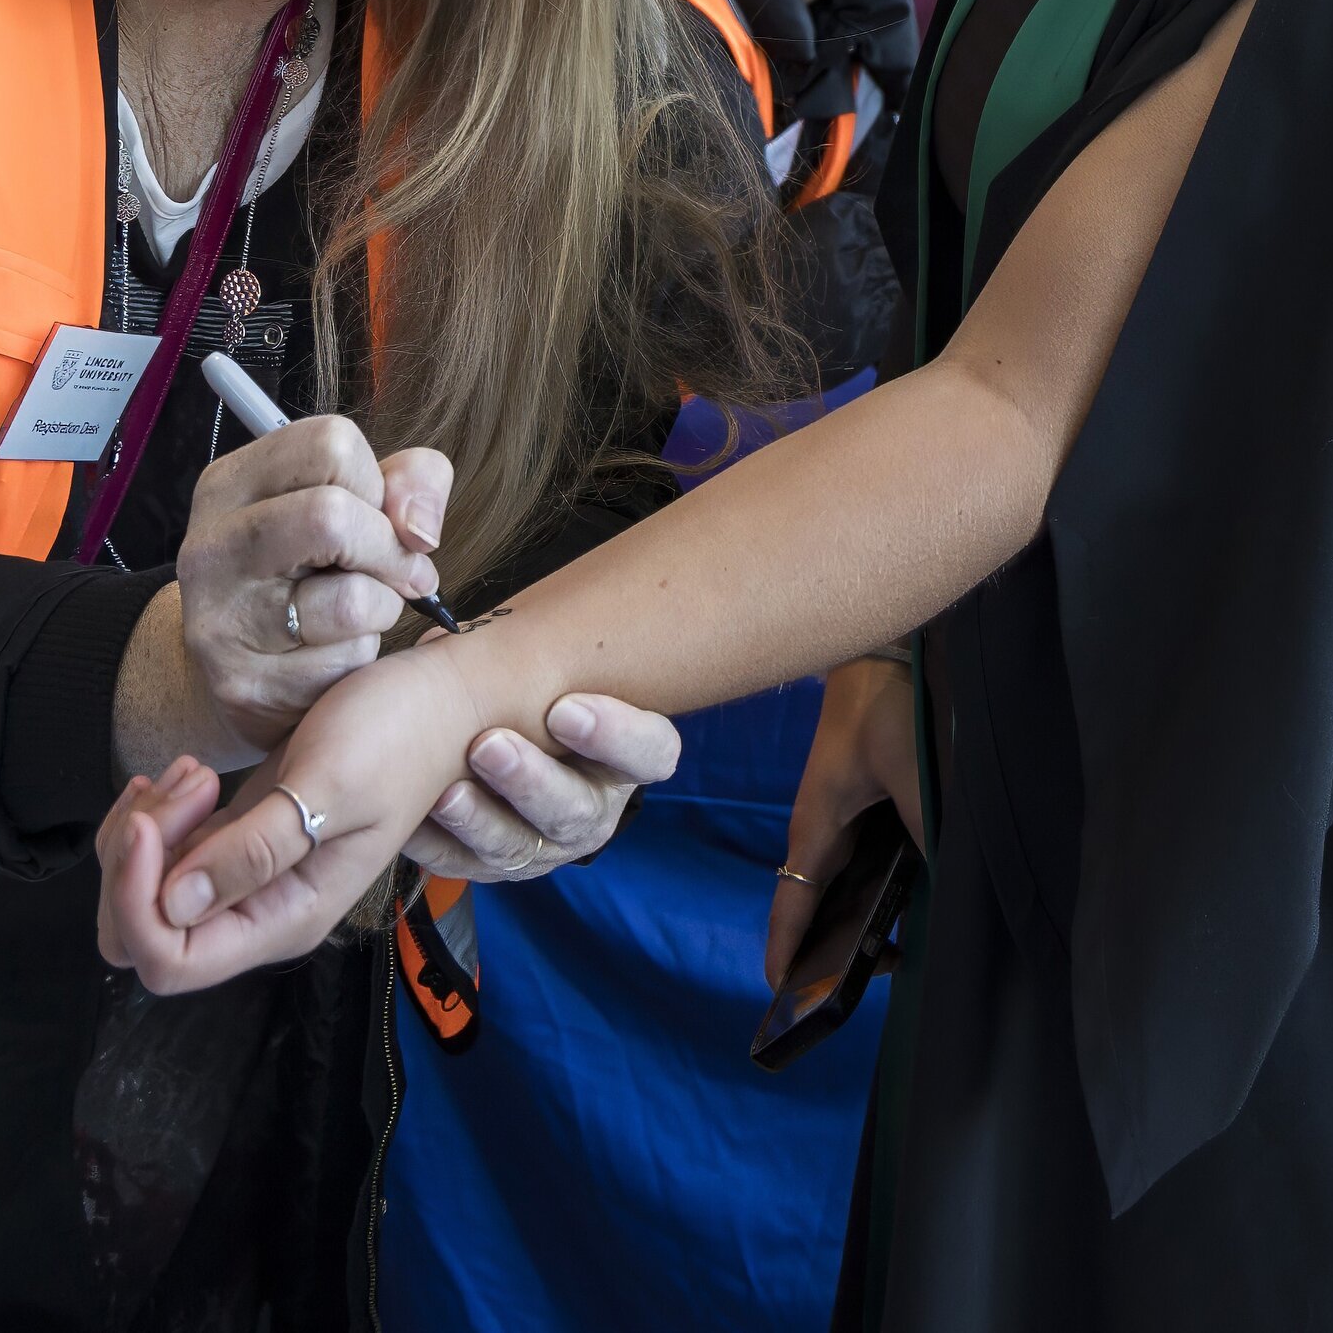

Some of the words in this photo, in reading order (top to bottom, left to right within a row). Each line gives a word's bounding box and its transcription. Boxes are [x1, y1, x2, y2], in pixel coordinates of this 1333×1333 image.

[84, 356, 125, 369] LINCOLN
[79, 369, 135, 382] UNIVERSITY
[32, 419, 81, 436] Registration
